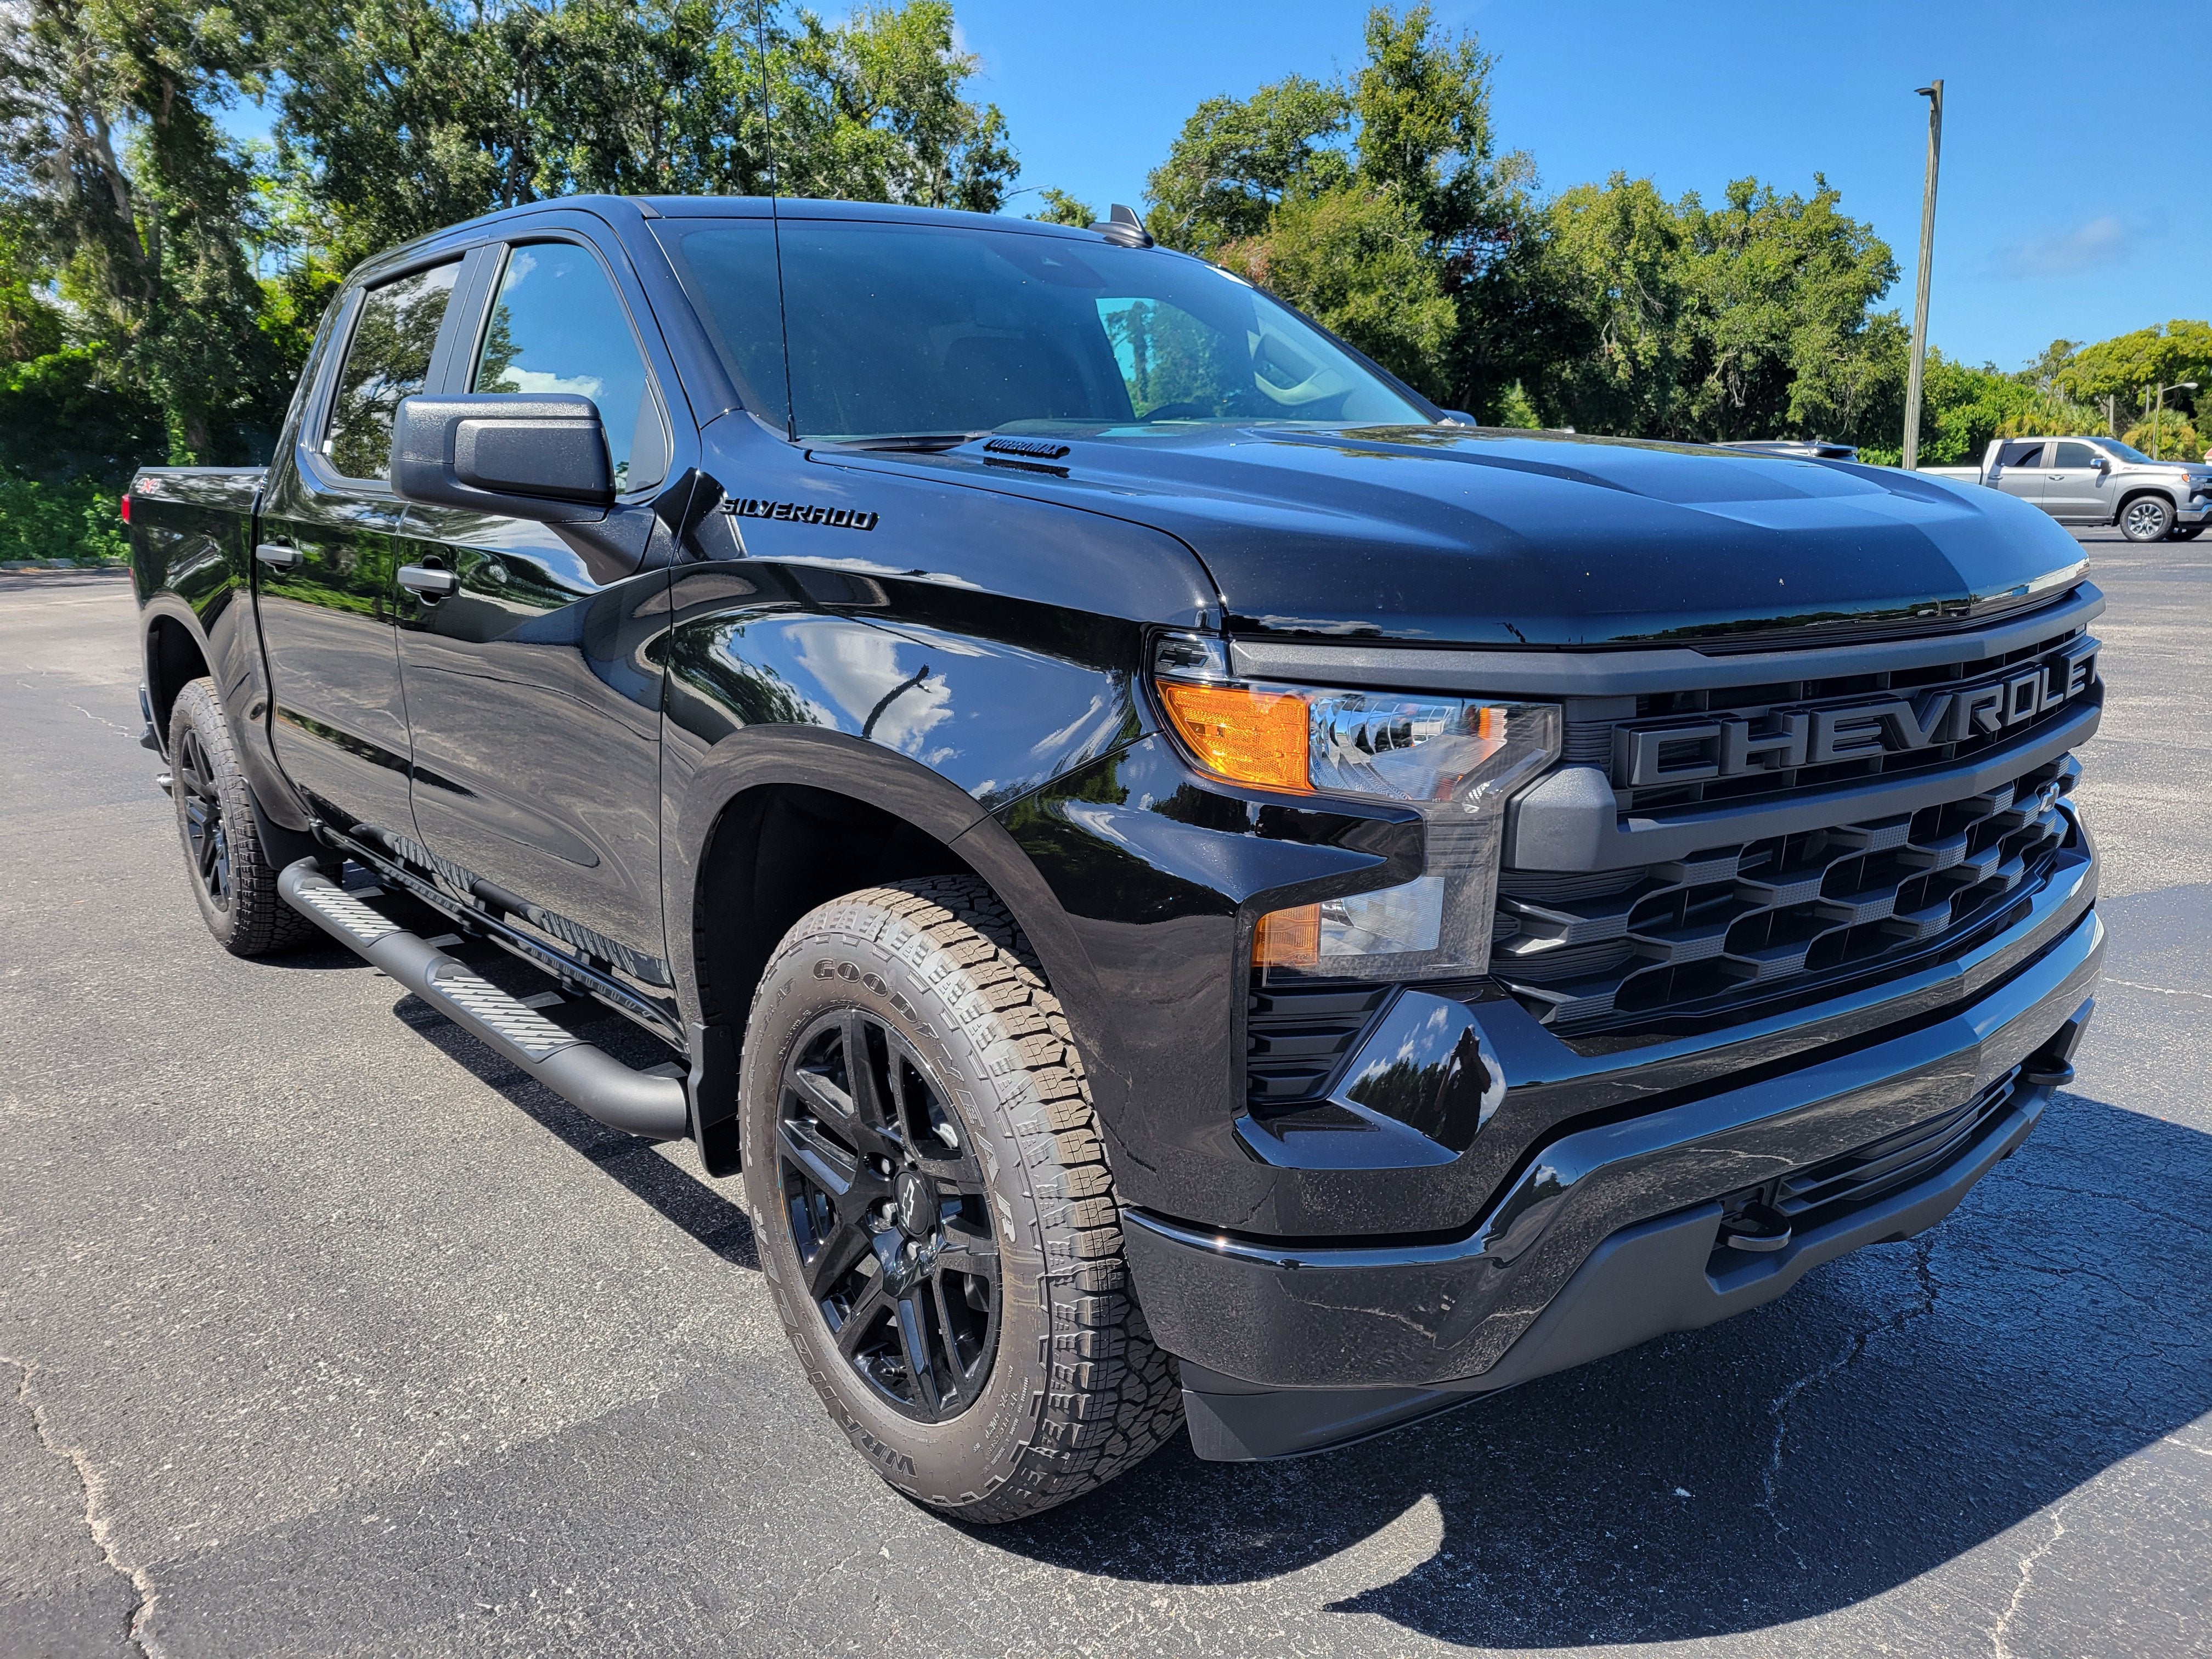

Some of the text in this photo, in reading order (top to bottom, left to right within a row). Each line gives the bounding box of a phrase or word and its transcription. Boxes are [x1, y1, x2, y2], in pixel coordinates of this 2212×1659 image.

[720, 498, 879, 531] SILVERADO
[983, 439, 1070, 460] TURBOMAX
[812, 957, 1017, 1243] GOODYEAR
[753, 1204, 918, 1479] WRANGLER
